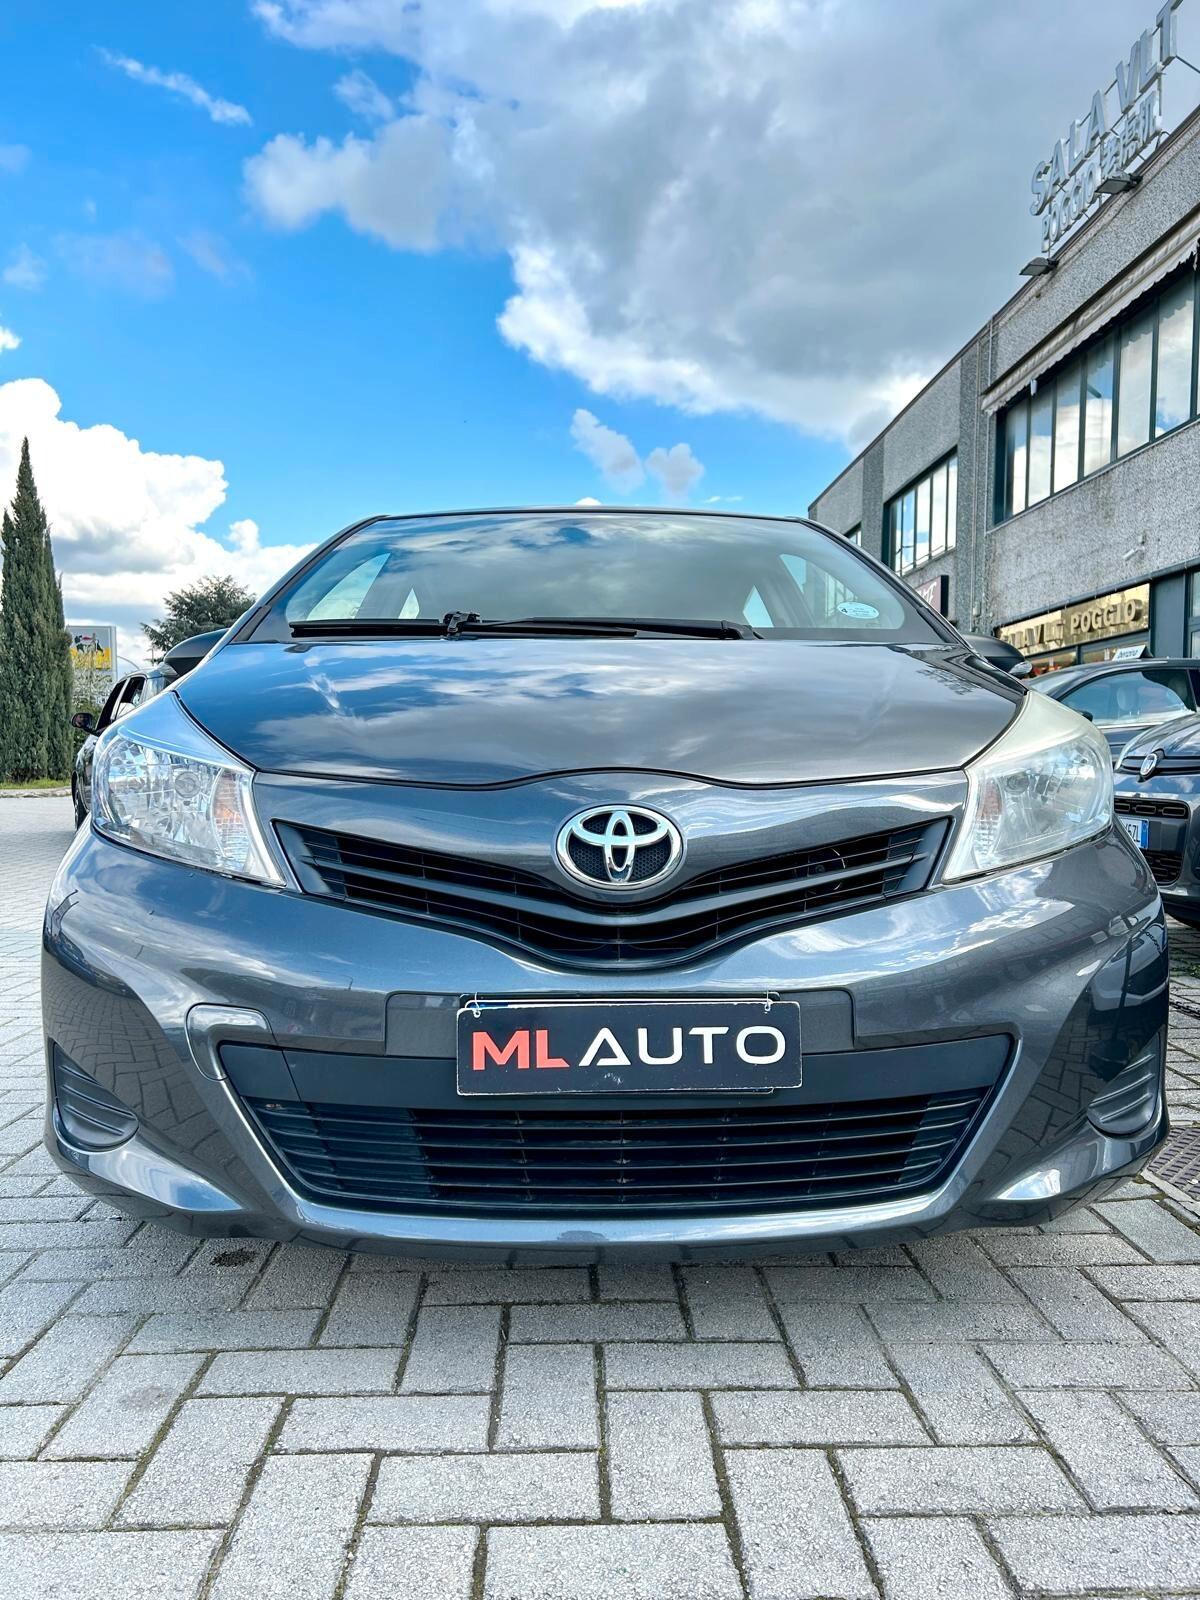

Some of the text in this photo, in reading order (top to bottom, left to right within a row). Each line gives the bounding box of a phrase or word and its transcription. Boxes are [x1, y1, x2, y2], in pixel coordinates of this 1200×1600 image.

[1030, 0, 1183, 216] SALA VLT
[1041, 162, 1102, 253] POGGIO
[1071, 598, 1142, 635] POGGIO
[472, 1025, 787, 1070] ML AUTO
